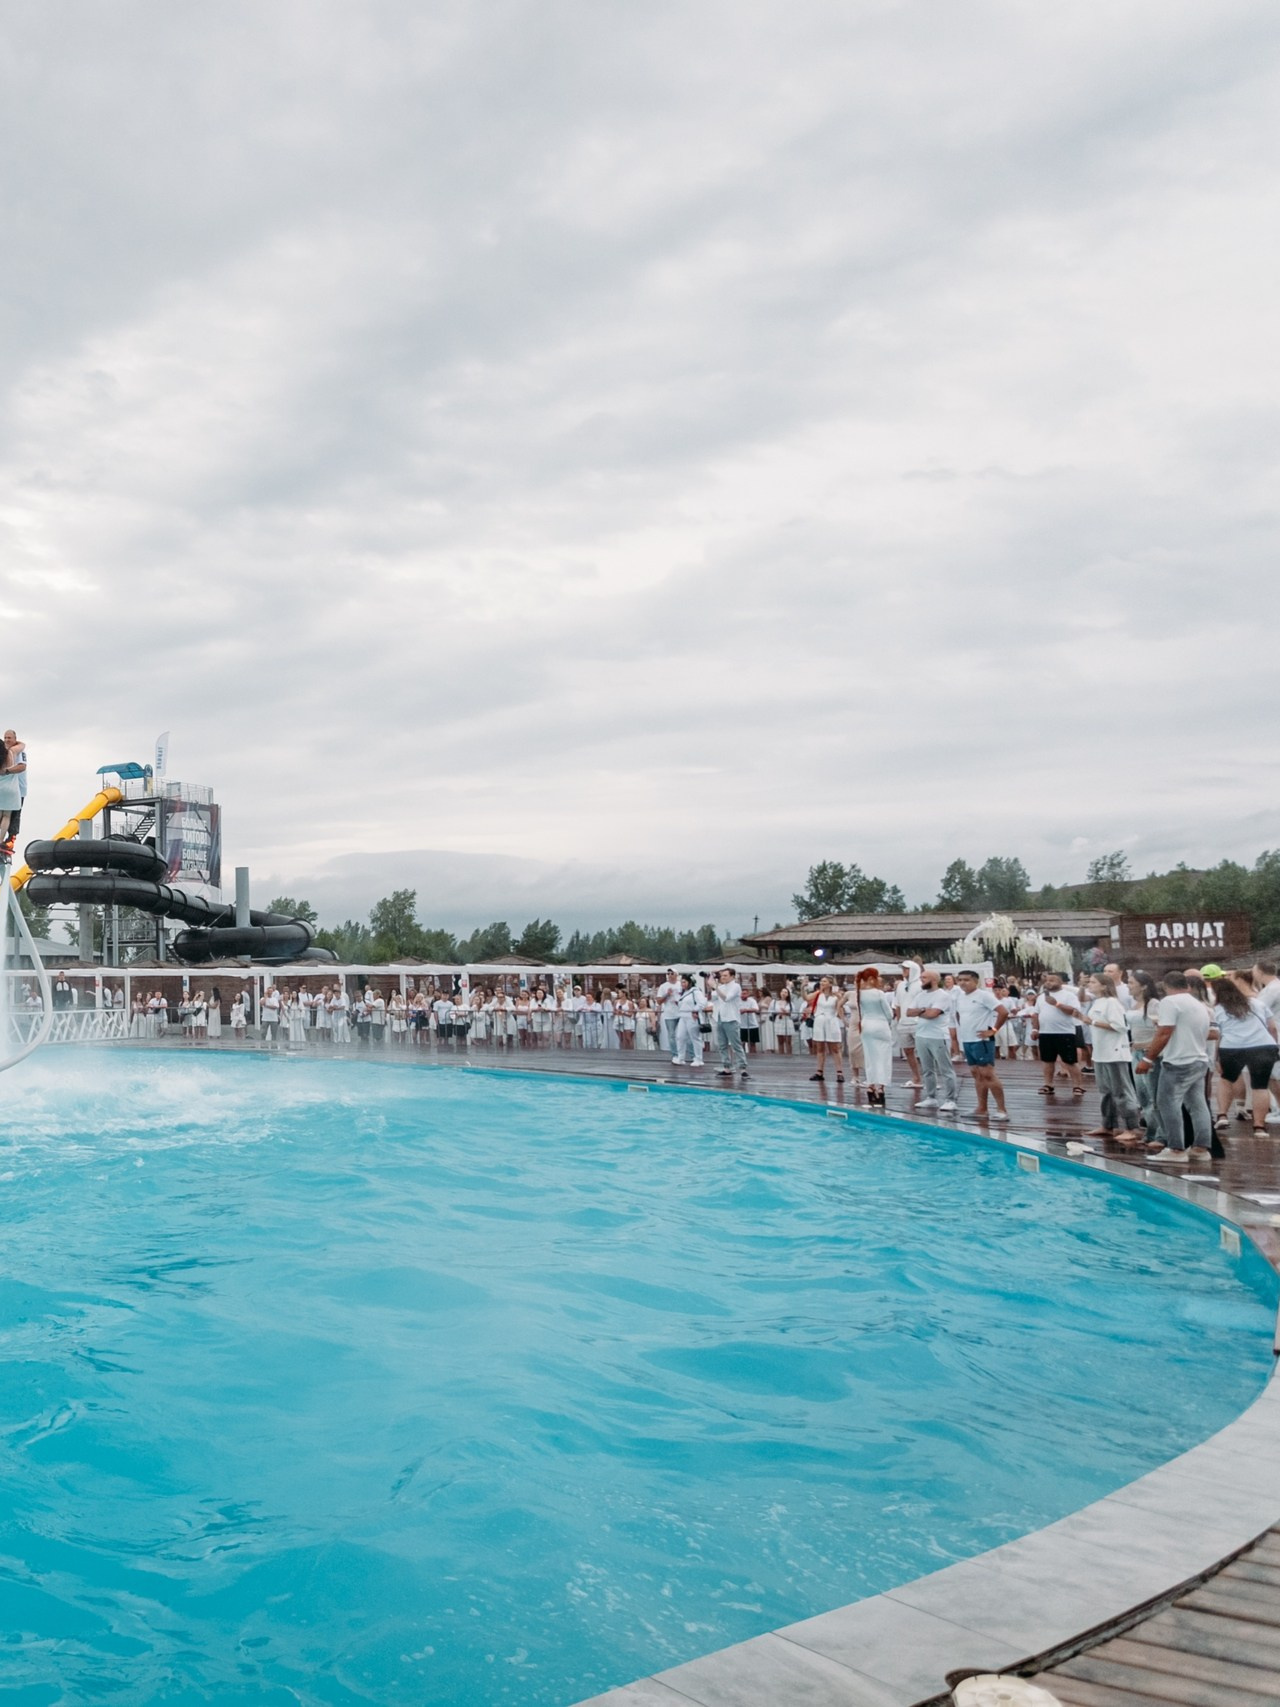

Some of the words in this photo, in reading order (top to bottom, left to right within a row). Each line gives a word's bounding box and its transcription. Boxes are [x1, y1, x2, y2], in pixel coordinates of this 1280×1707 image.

[182, 849, 207, 862] БОЛЬШЕ
[1145, 922, 1225, 939] BARHAT
[1147, 940, 1184, 948] BEACH
[1193, 940, 1224, 948] CLUB
